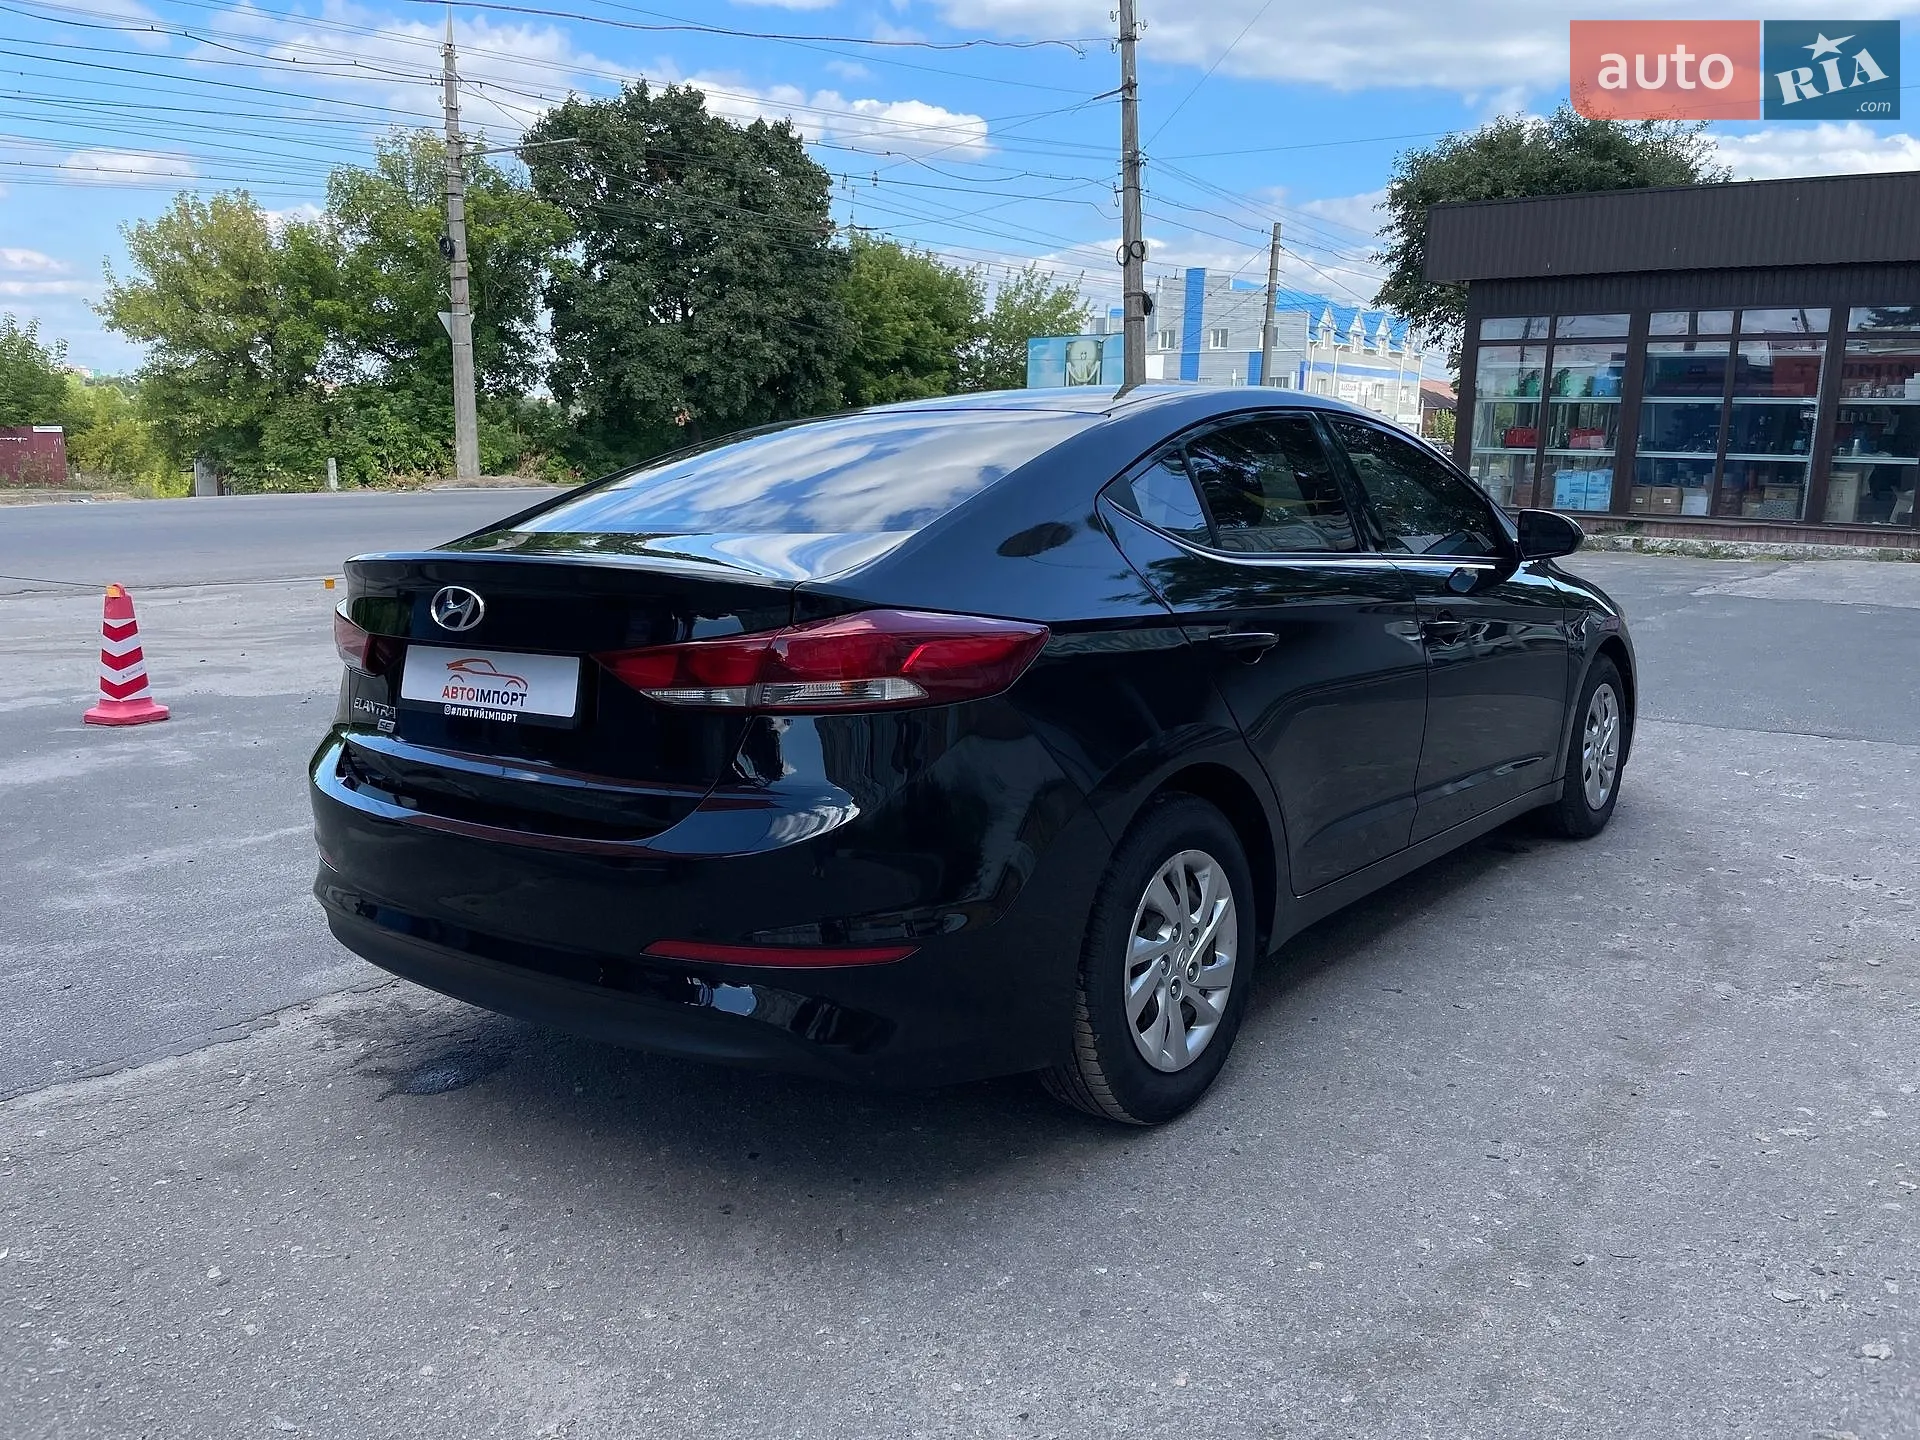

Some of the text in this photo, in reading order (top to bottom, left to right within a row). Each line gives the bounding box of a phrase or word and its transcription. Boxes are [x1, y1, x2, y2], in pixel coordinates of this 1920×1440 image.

[441, 685, 528, 707] АВТОІМПОРТ
[353, 697, 396, 719] ELANTRA
[378, 720, 393, 731] SE
